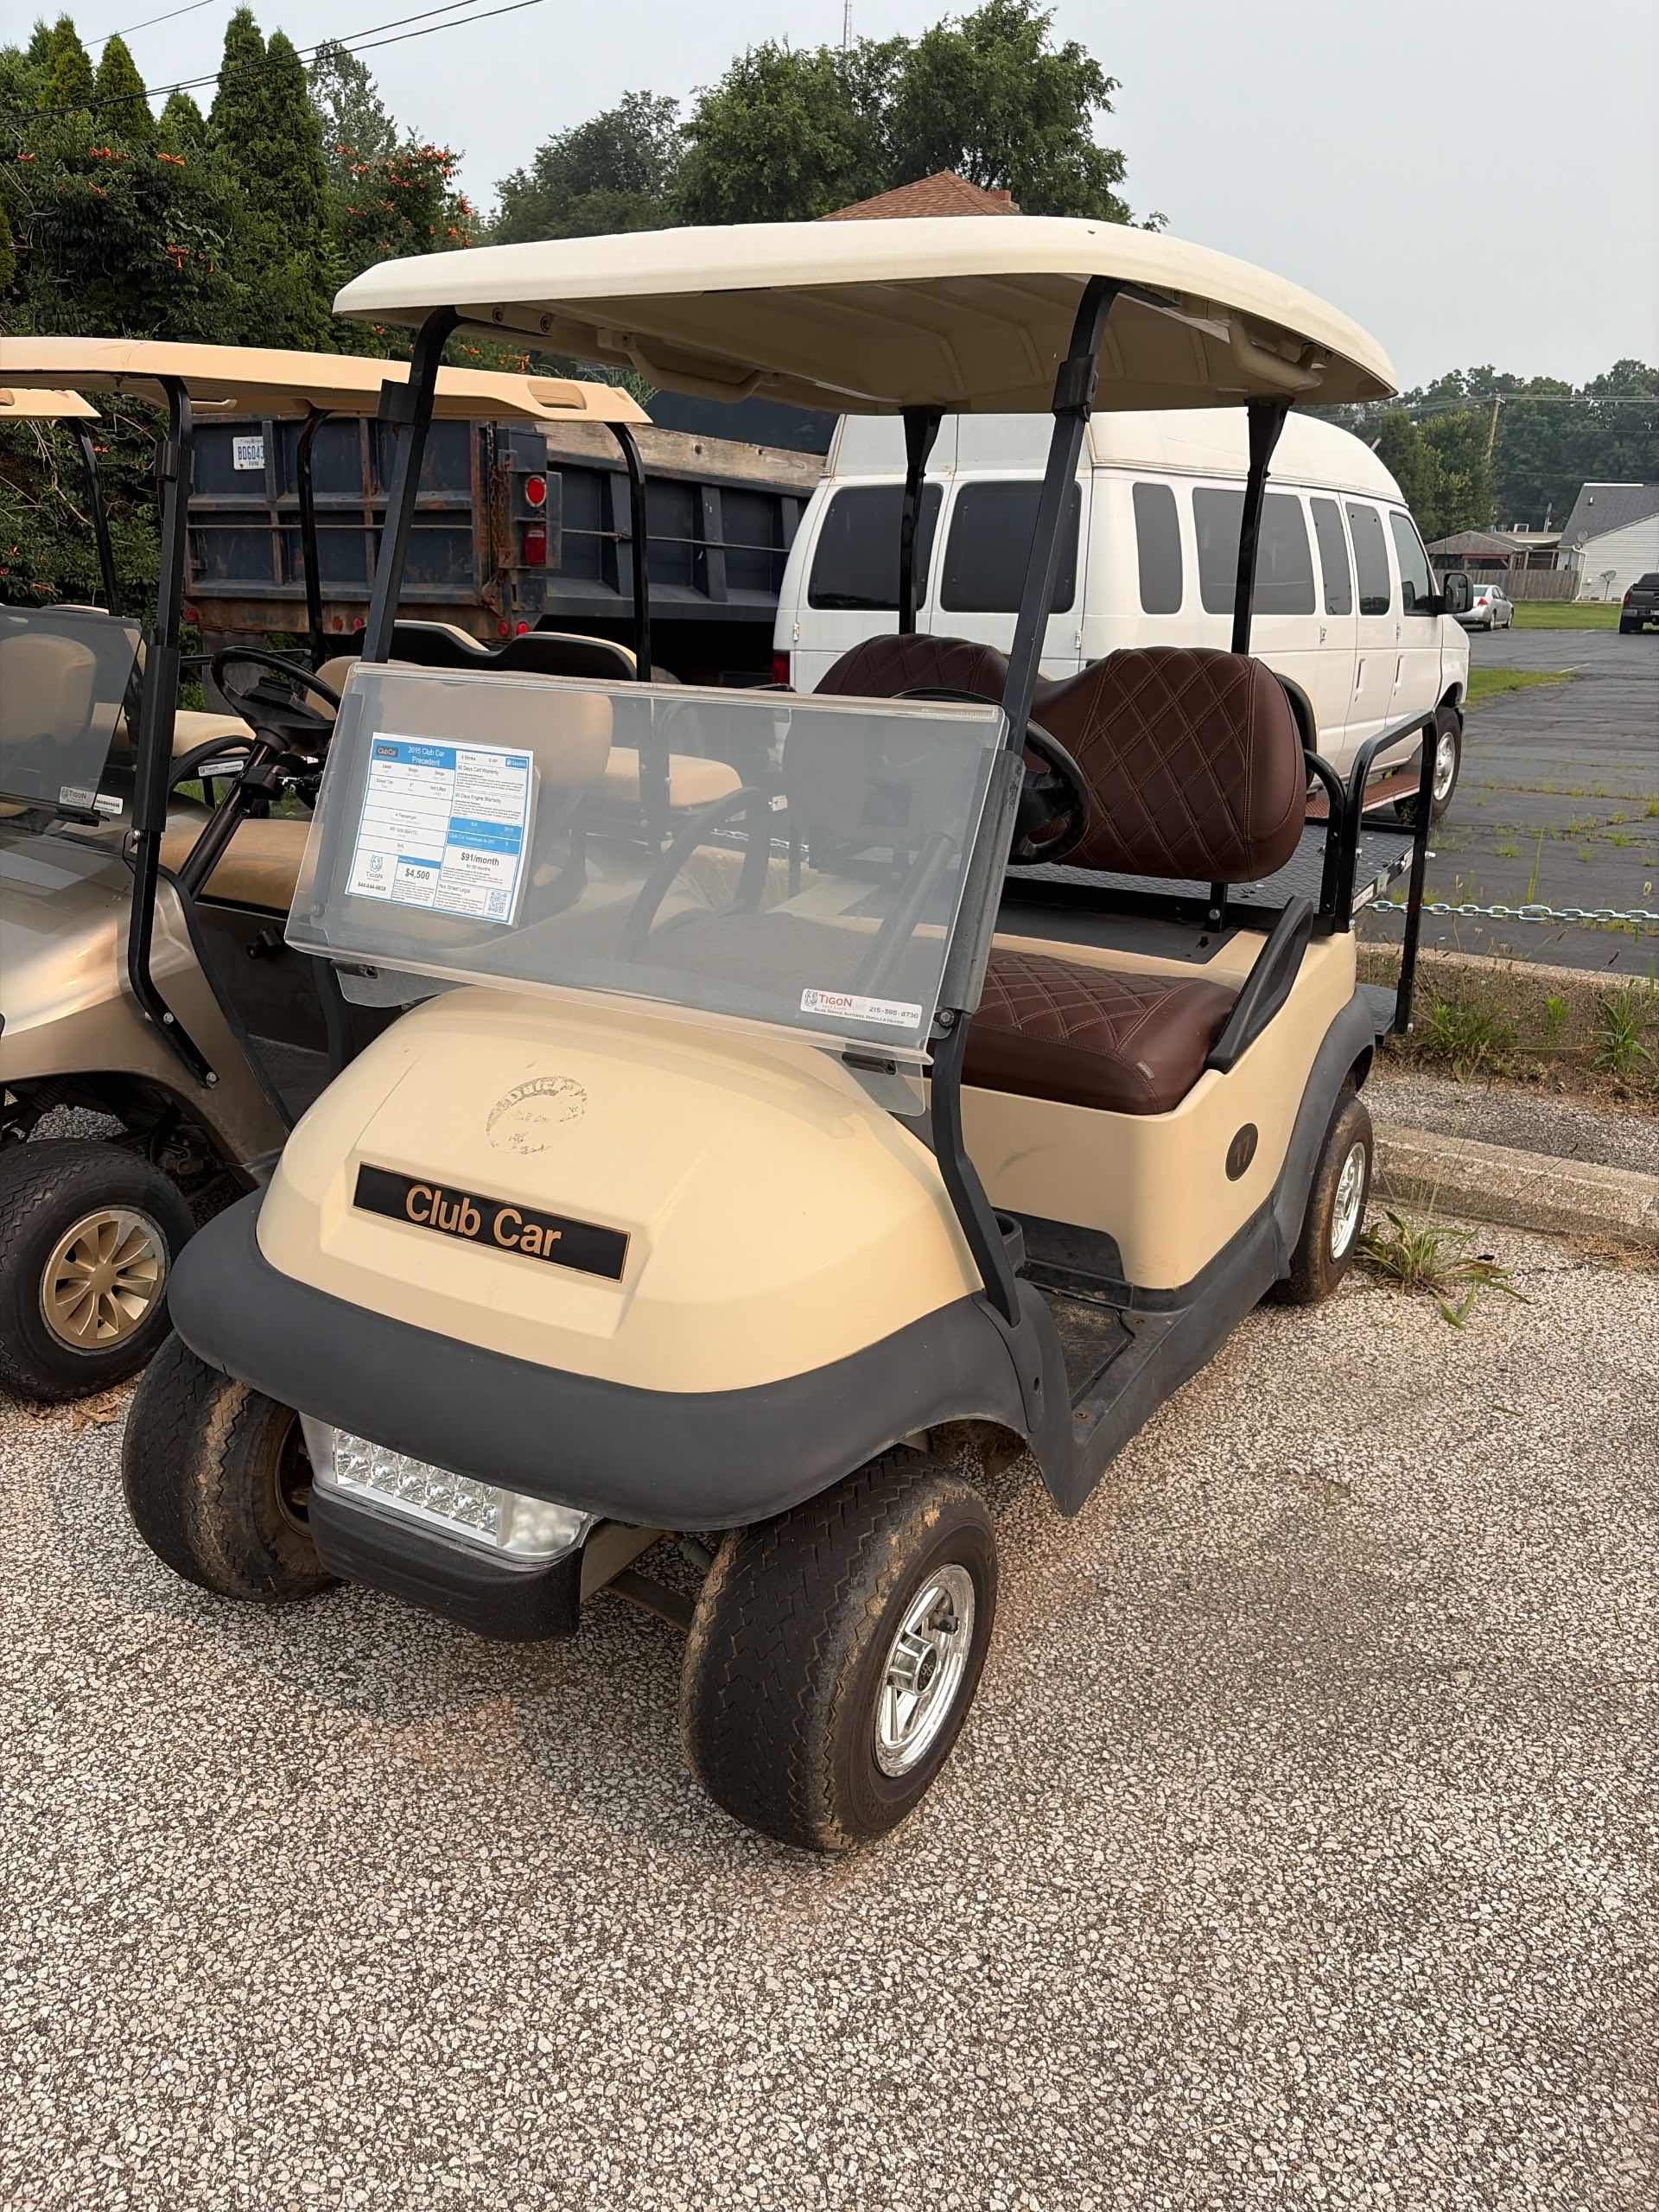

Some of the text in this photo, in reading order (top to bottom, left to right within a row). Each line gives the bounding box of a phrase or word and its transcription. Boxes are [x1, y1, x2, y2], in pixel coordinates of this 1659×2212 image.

[411, 756, 441, 766] Precedent
[461, 852, 499, 866] $91/month
[405, 1184, 562, 1256] Club Car
